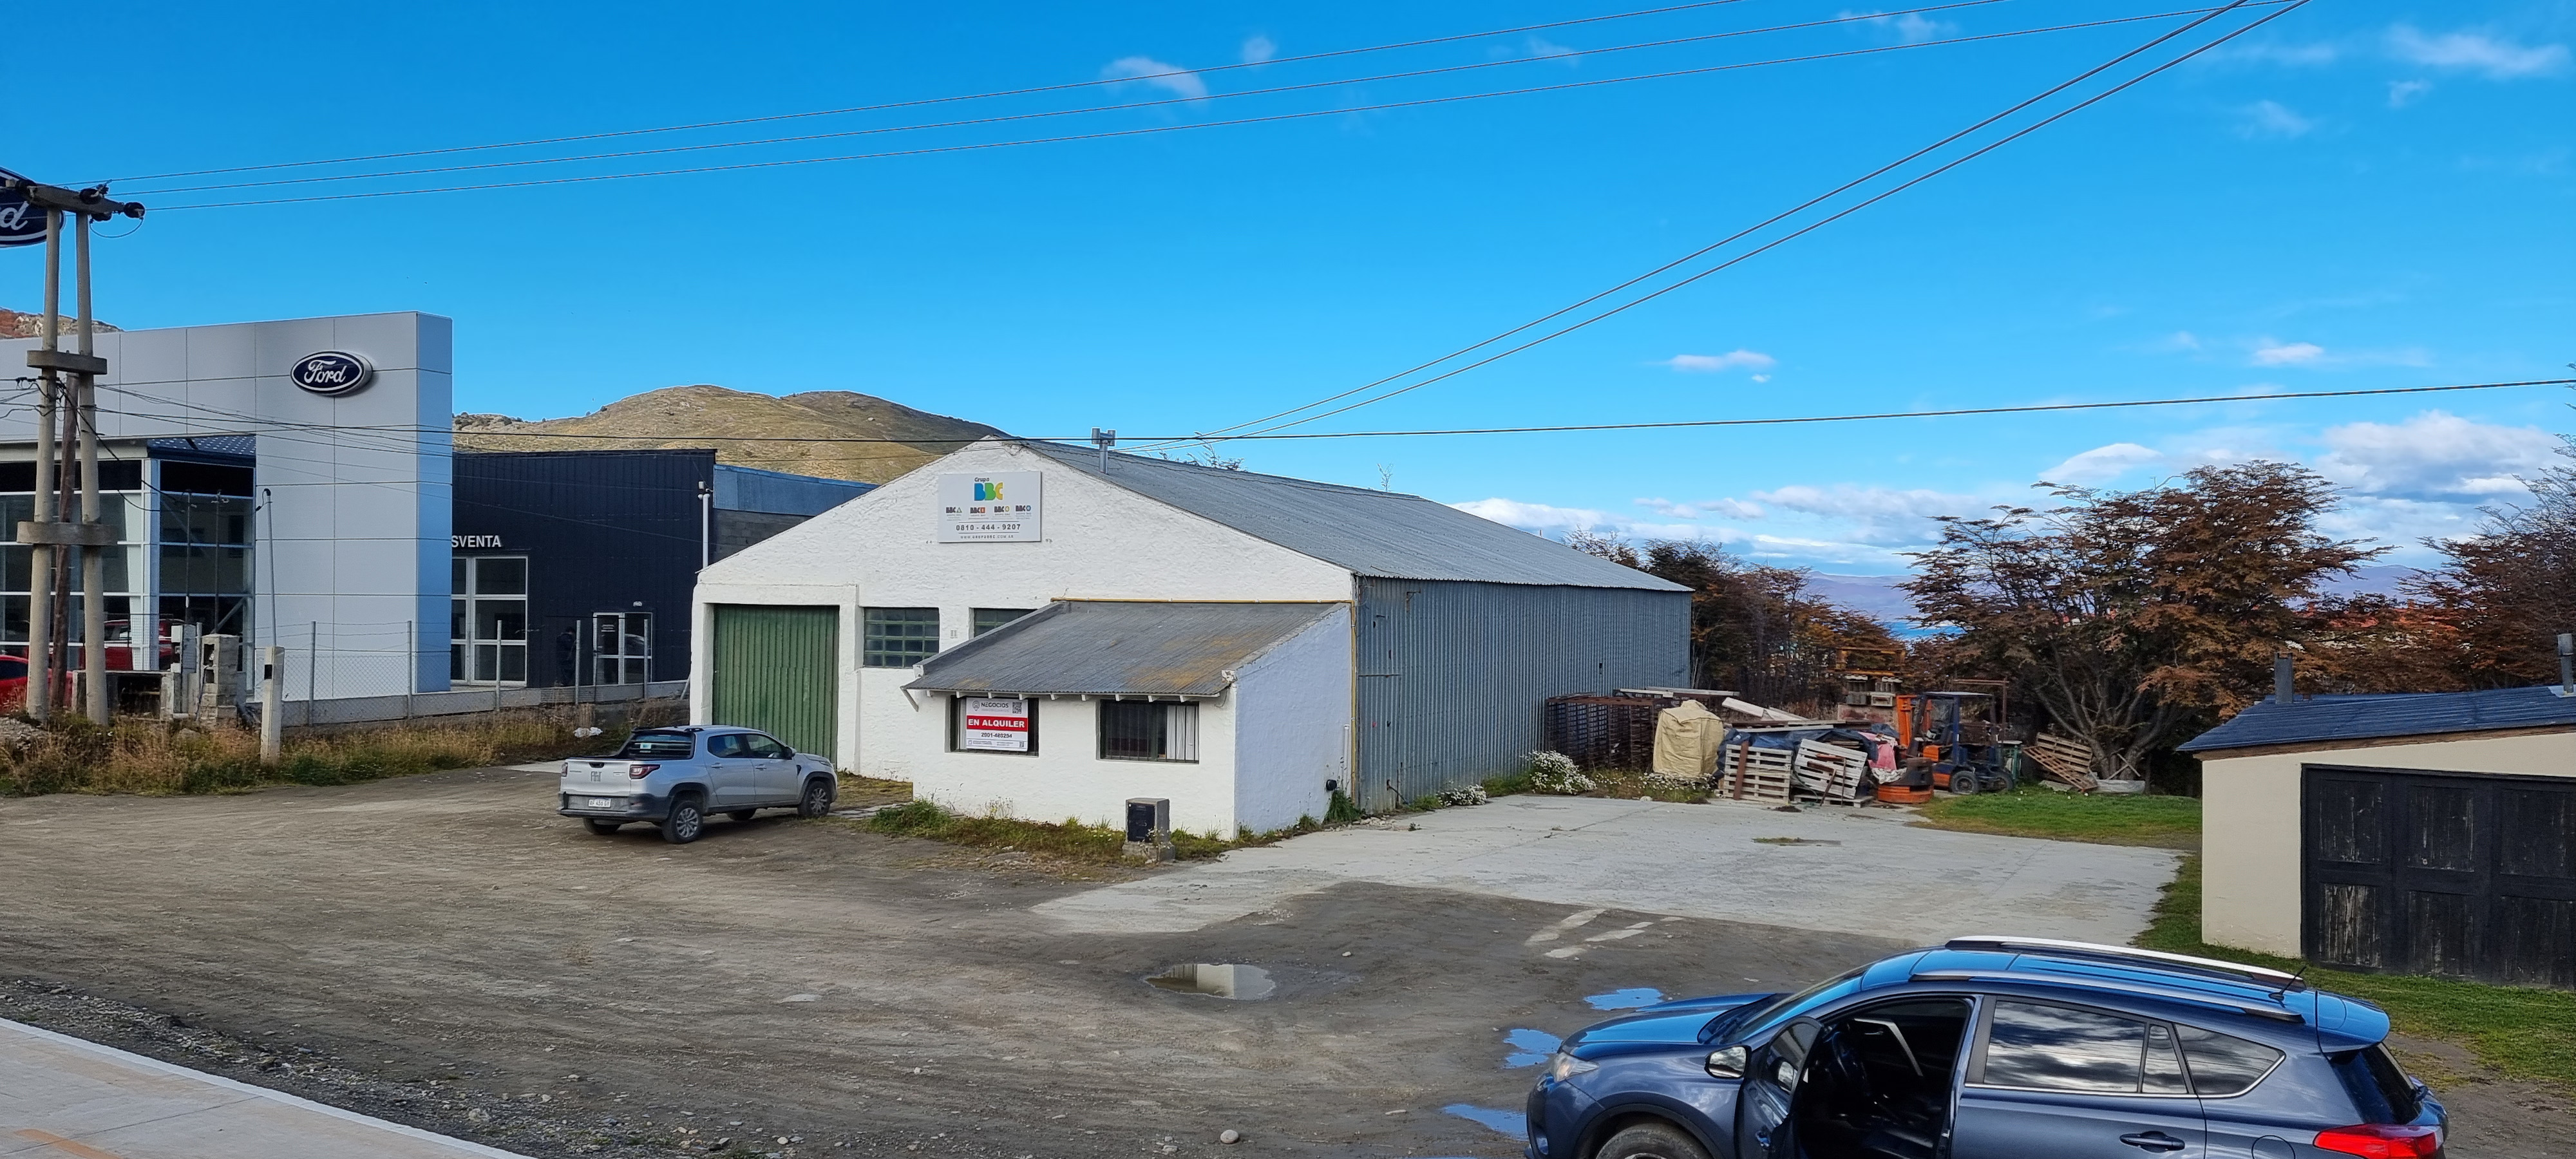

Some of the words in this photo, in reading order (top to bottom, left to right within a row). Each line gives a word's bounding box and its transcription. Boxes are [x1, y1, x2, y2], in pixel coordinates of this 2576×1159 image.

[303, 359, 348, 384] Ford
[974, 482, 1003, 502] BBC
[982, 719, 1025, 728] ALQUILER
